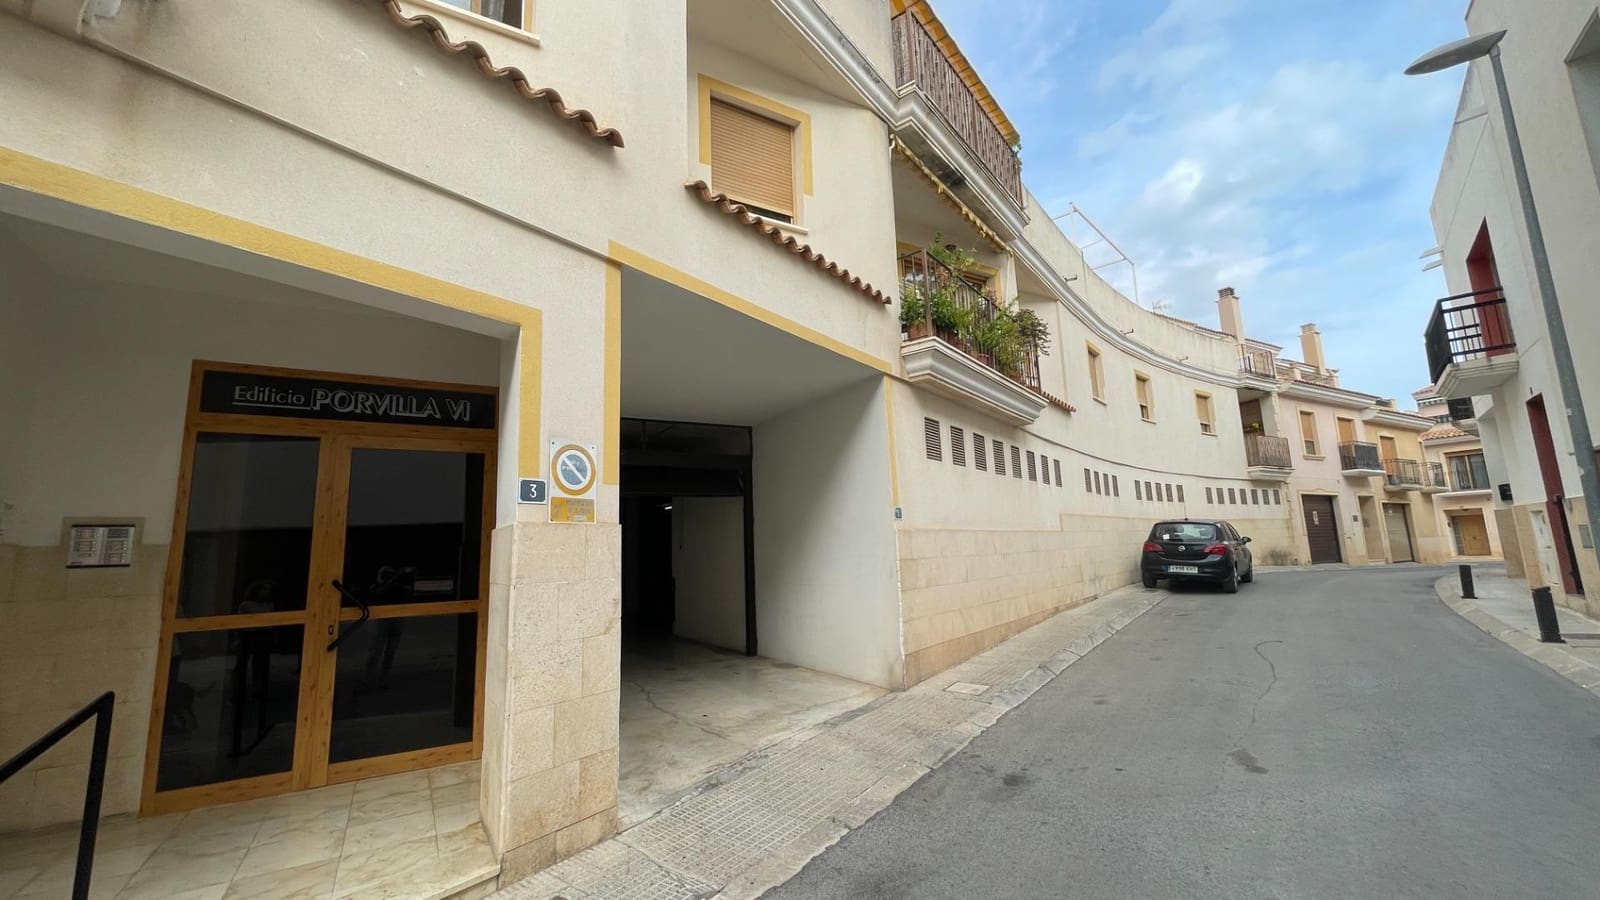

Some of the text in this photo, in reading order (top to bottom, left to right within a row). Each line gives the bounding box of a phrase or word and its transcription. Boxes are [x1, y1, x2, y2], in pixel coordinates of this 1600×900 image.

[234, 385, 471, 422] Edificio PORVILLA VI
[529, 484, 537, 498] 3
